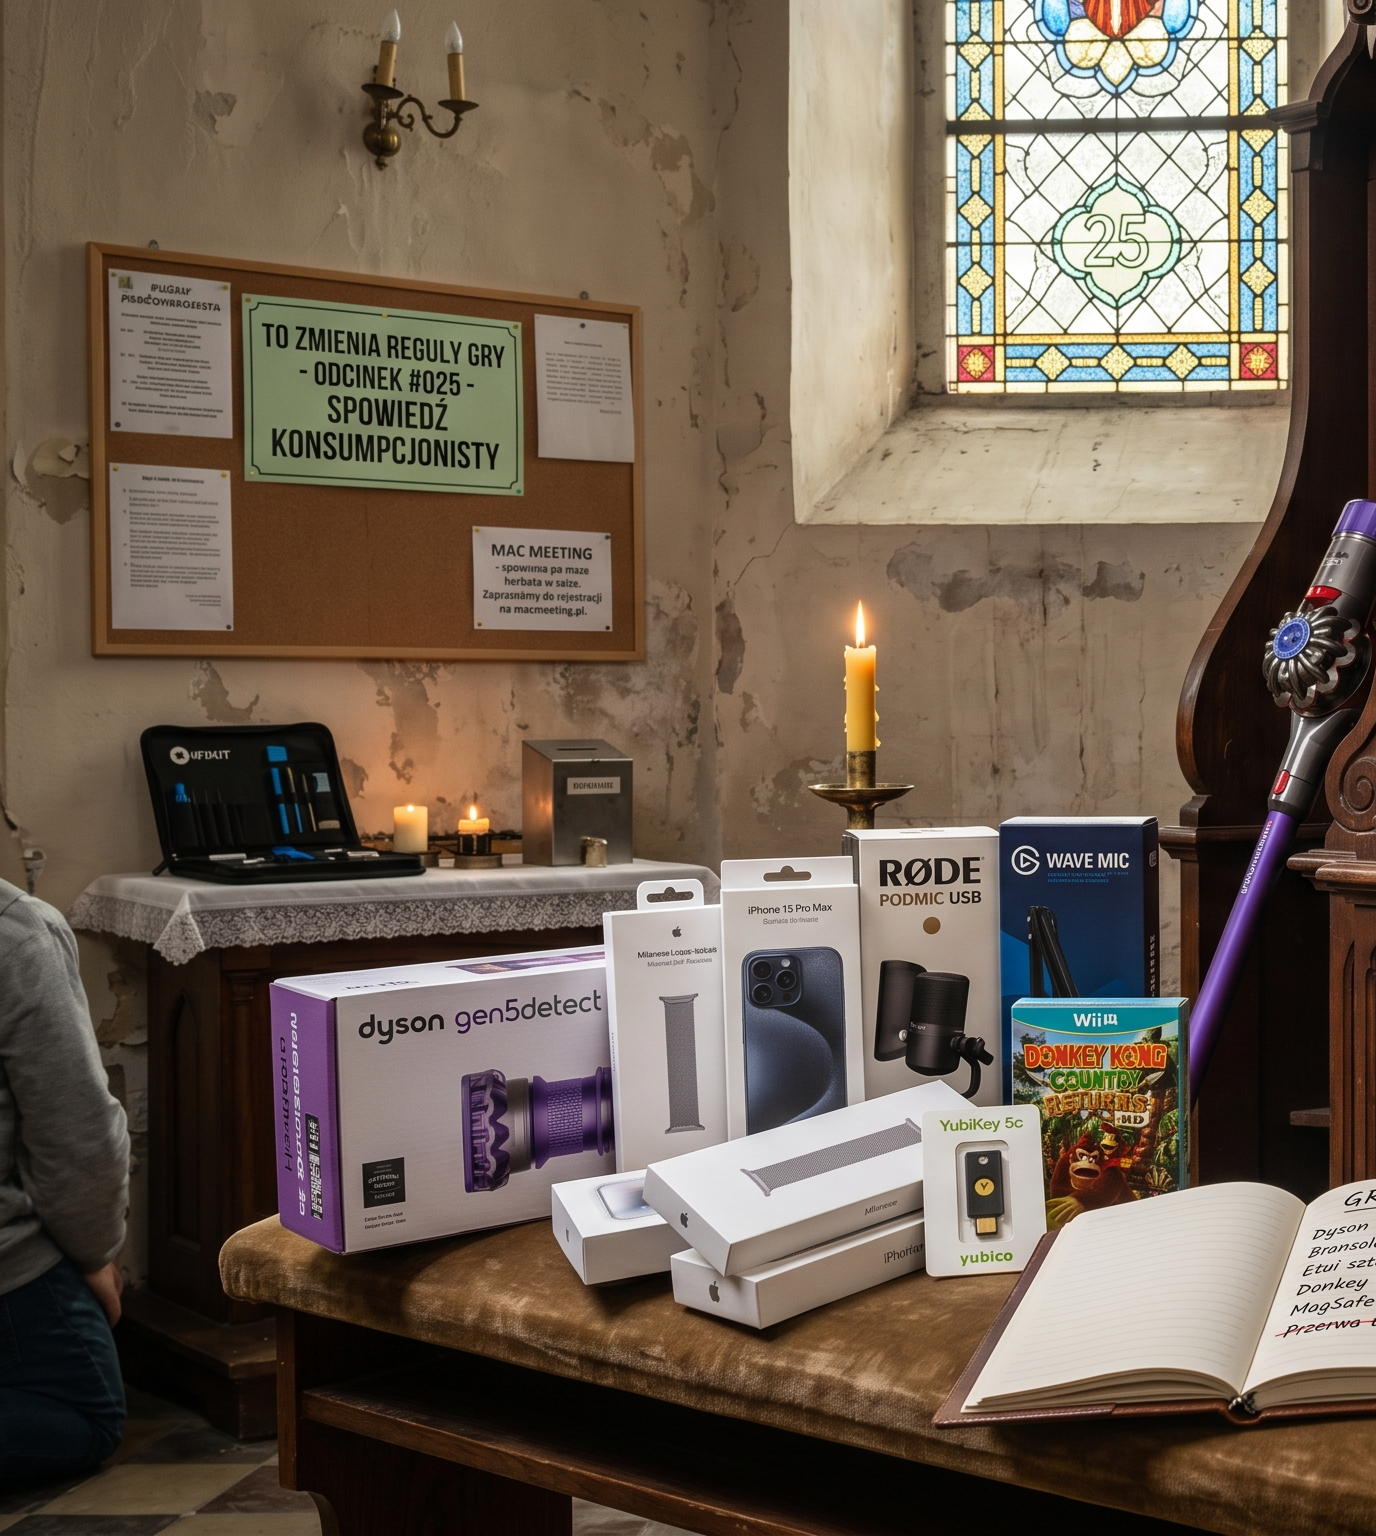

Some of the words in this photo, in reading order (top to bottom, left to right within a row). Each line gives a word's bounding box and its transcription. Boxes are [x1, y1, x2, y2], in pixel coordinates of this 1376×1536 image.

[1084, 214, 1149, 268] 25
[262, 323, 289, 349] TO
[295, 325, 382, 358] ZMIENIA
[387, 334, 463, 365] REGULY
[467, 342, 505, 369] GRY
[314, 360, 403, 392] ODCINEK
[409, 368, 461, 397] #025
[327, 395, 448, 431] SPOWIEDŹ
[271, 427, 500, 471] KONSUMPCJONISTY
[491, 543, 525, 558] MAC
[529, 545, 593, 560] MEETING
[565, 566, 590, 575] maze
[504, 576, 542, 587] herbata
[543, 591, 555, 601] do
[557, 592, 603, 605] rejestracji
[499, 605, 512, 614] na
[514, 605, 588, 617] macmeeting.pl.
[1046, 852, 1094, 869] WAVE
[1097, 852, 1130, 869] MIC
[878, 856, 982, 887] RØDE
[879, 891, 945, 907] PODMIC
[949, 890, 982, 905] USB
[747, 906, 781, 915] iPhone
[782, 904, 794, 913] 15
[795, 904, 811, 913] Pro
[812, 903, 833, 912] Max
[358, 1013, 445, 1045] dyson
[454, 989, 602, 1035] gen5detect
[1073, 1013, 1102, 1027] Wii
[1023, 1043, 1109, 1069] DONKEY
[1109, 1043, 1168, 1069] KONG
[939, 1118, 1001, 1132] YubiKey
[1004, 1117, 1024, 1130] 5c
[1312, 1223, 1369, 1241] Dyson
[960, 1251, 1013, 1267] yubico
[1302, 1260, 1341, 1277] Etui
[1296, 1277, 1369, 1296] Donkey
[1290, 1294, 1375, 1317] MagSafe
[1283, 1318, 1361, 1338] Przerwa
